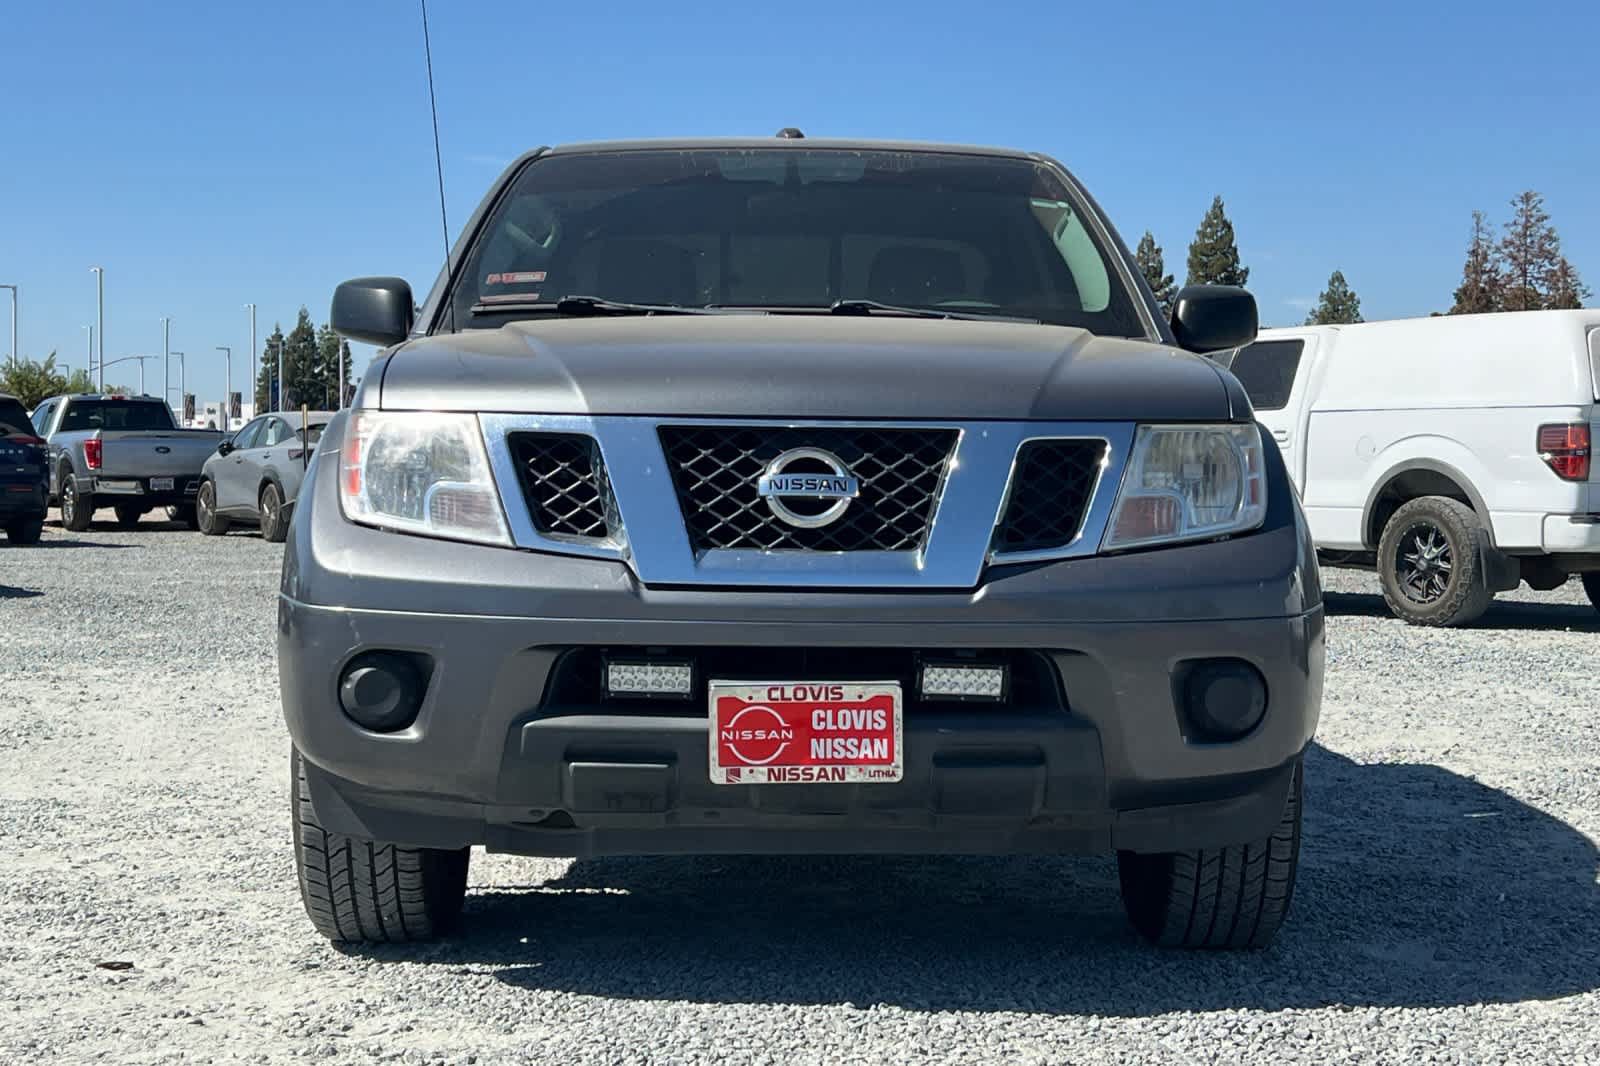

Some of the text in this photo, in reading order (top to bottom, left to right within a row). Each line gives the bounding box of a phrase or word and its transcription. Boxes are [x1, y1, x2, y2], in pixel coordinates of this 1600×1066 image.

[769, 479, 847, 492] NISSAN
[767, 686, 844, 701] CLOVIS
[811, 709, 887, 730] CLOVIS
[721, 729, 793, 740] NISSAN
[810, 738, 888, 760] NISSAN
[767, 767, 846, 782] NISSAN
[868, 769, 897, 778] LITHIA
